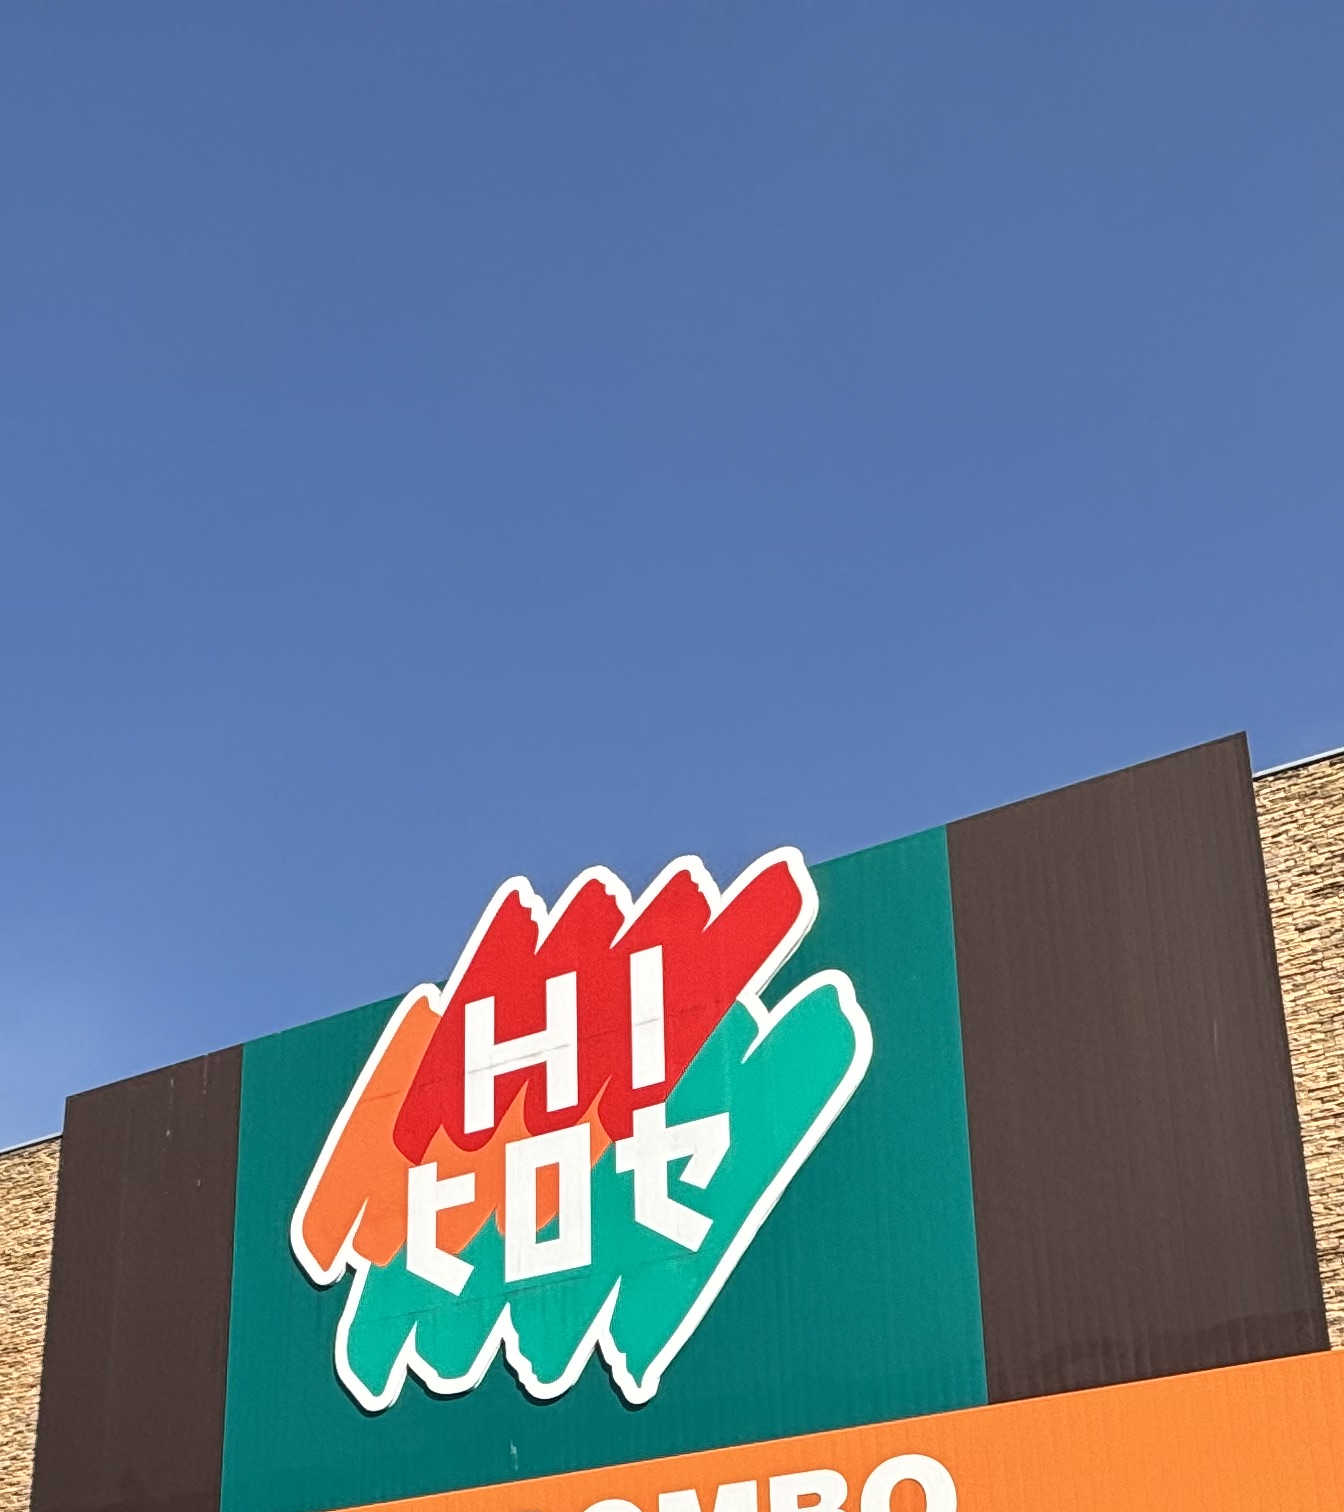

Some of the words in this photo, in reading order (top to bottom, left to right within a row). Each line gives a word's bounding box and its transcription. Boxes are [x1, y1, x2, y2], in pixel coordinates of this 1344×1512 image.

[465, 945, 665, 1133] HI
[406, 1101, 730, 1297] ヒロセ
